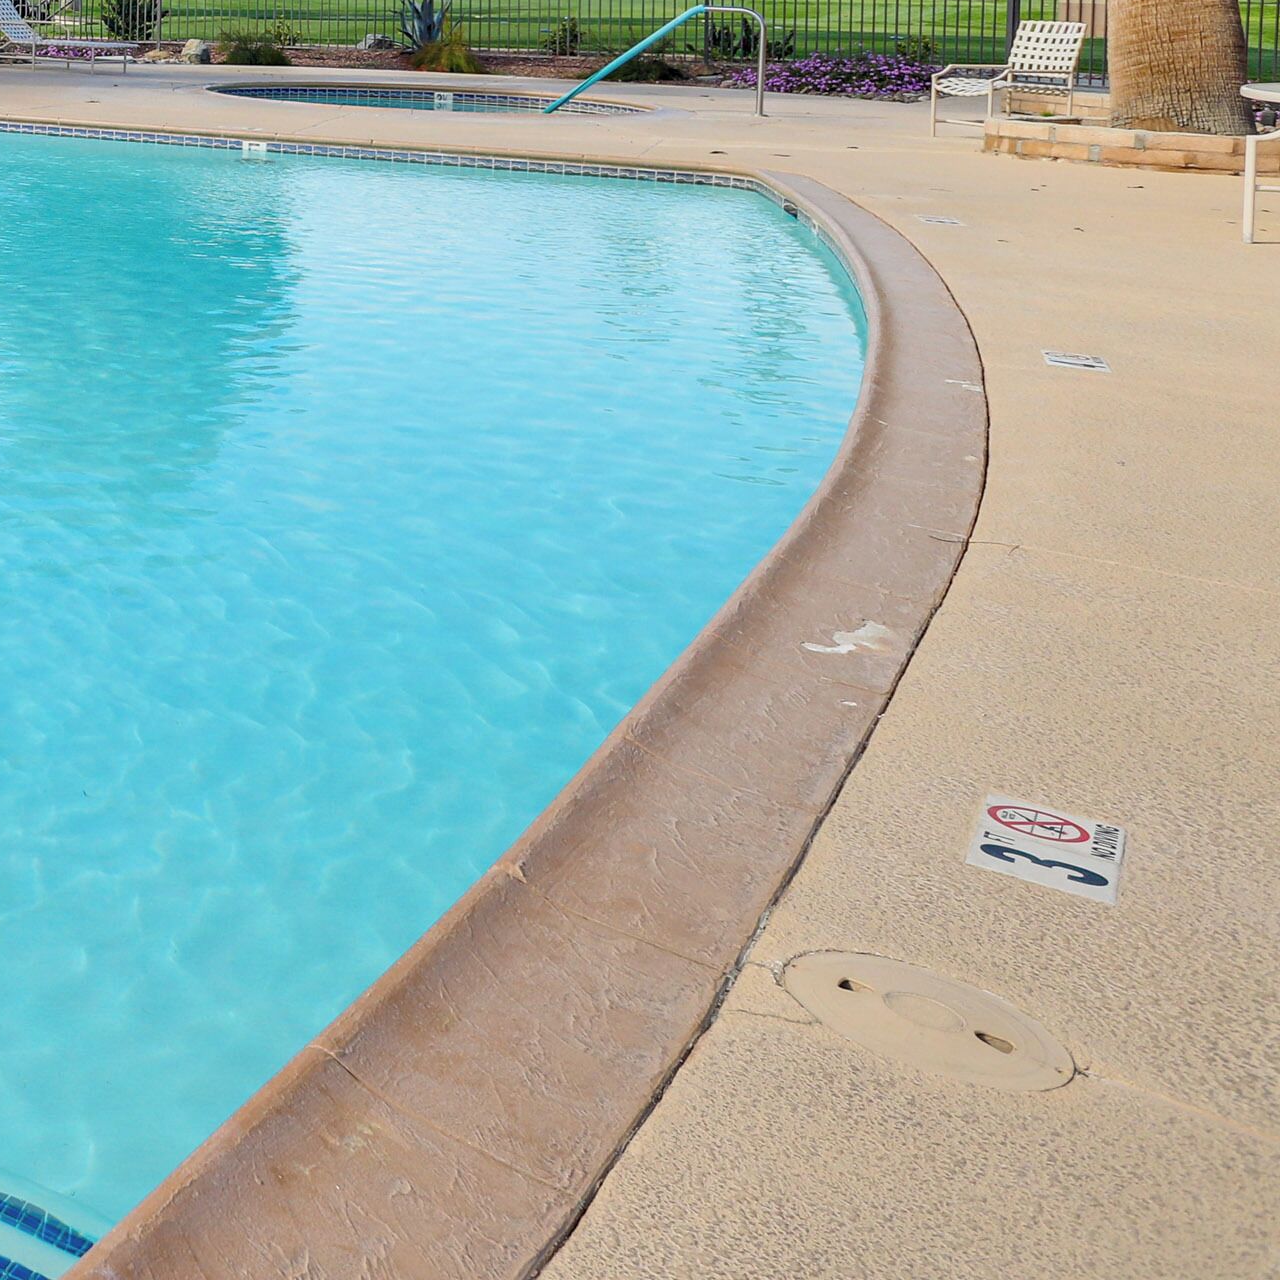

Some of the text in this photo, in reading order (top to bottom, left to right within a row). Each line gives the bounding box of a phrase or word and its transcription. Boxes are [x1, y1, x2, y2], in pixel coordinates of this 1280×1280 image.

[1090, 824, 1120, 861] NO DIVING
[980, 843, 1109, 886] 3
